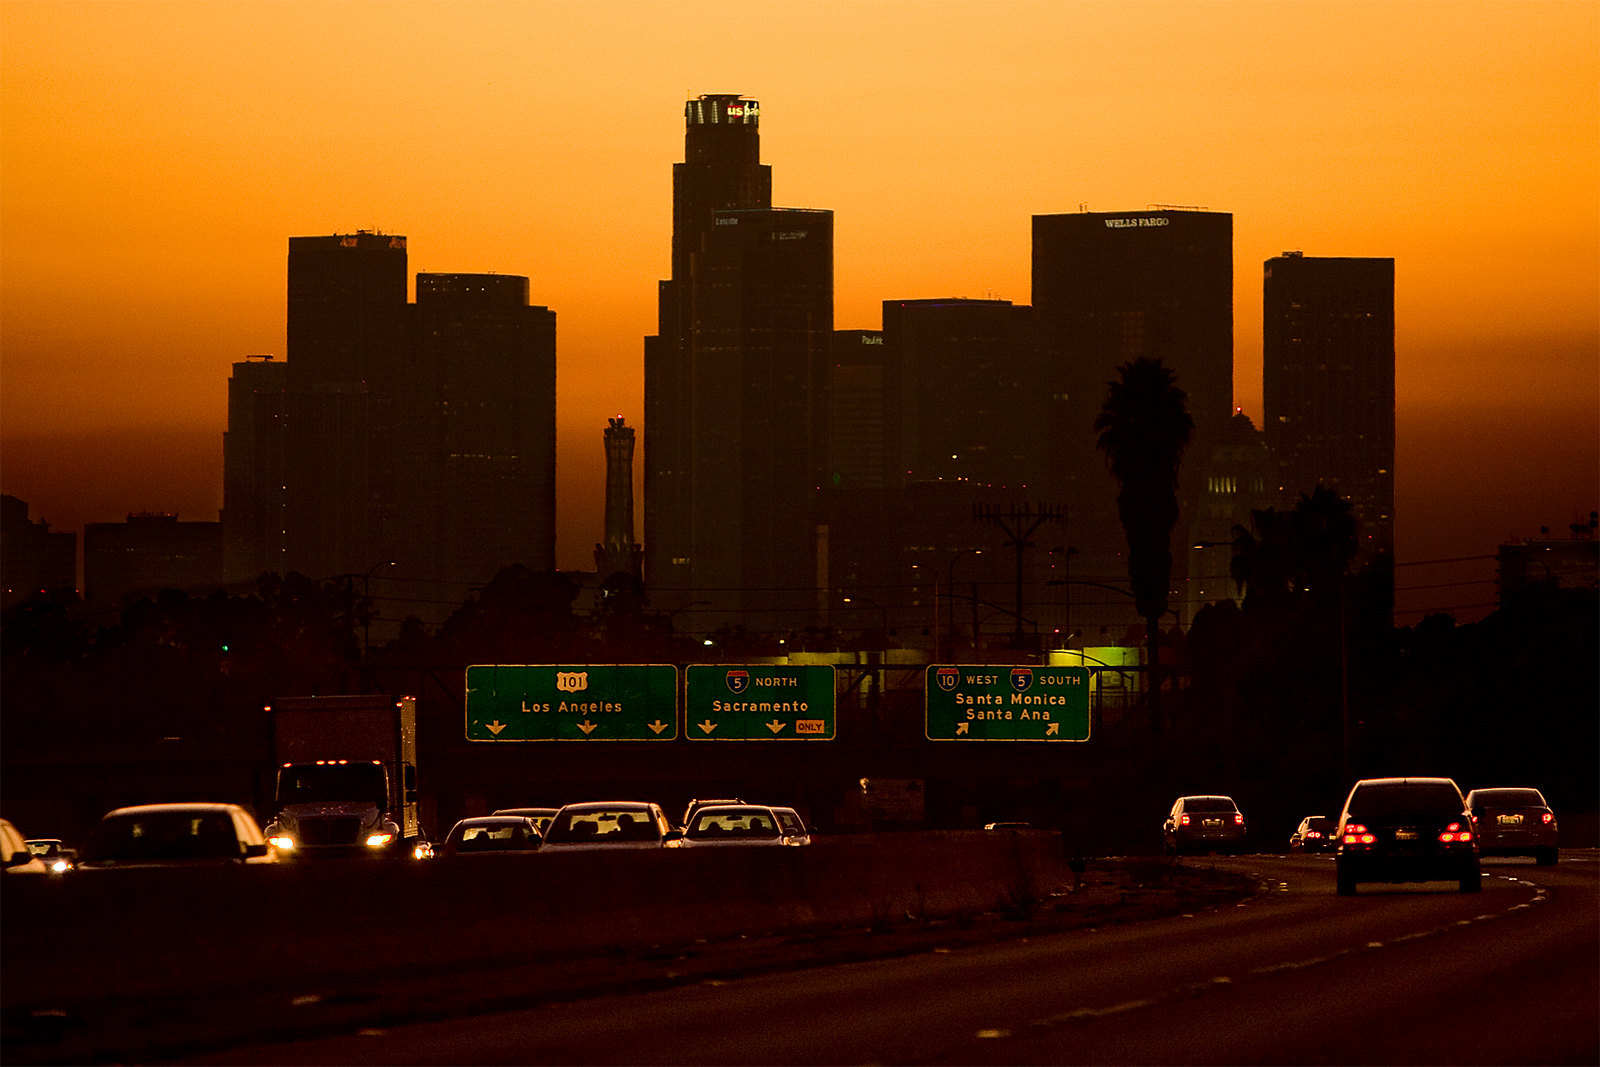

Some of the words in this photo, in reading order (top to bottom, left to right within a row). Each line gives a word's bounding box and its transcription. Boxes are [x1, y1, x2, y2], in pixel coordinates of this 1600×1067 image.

[1105, 219, 1137, 228] WELLS
[1139, 218, 1169, 227] FARGO
[562, 676, 583, 687] 101
[734, 678, 742, 688] 5
[755, 677, 798, 687] NORTH
[942, 675, 955, 687] 10
[966, 675, 999, 685] WEST
[1018, 675, 1026, 687] 5
[1039, 676, 1081, 686] SOUTH
[955, 693, 1003, 705] Santa
[1011, 693, 1066, 705] Monica
[522, 701, 550, 712] Los
[558, 701, 622, 715] Angeles
[712, 700, 809, 712] Sacramento
[966, 708, 1013, 720] Santa
[1020, 708, 1050, 720] Ana
[798, 723, 822, 731] ONLY
